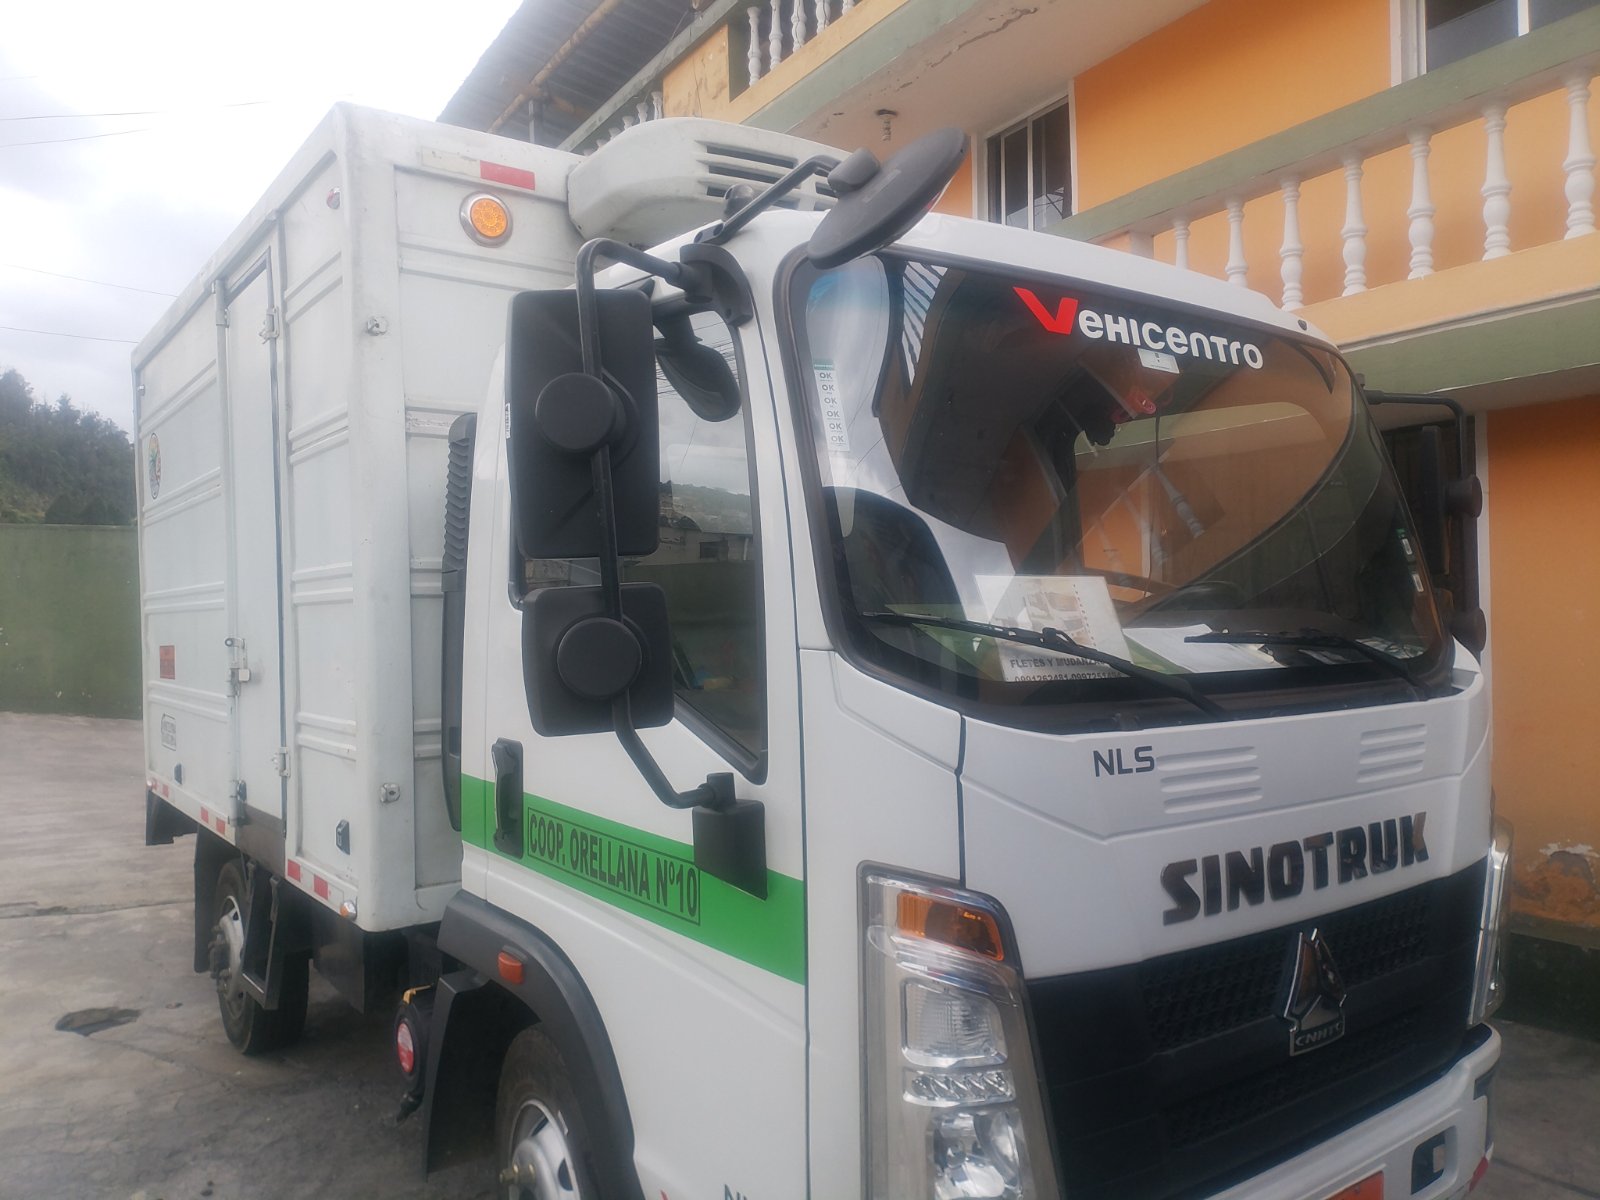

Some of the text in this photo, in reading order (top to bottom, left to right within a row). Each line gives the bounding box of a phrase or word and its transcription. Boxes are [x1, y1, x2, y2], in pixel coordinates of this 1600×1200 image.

[1010, 658, 1046, 668] FLETES
[1092, 745, 1155, 777] NLS
[529, 813, 566, 866] COOP.
[569, 828, 651, 901] ORELLANA
[1160, 811, 1429, 926] SINOTRUK
